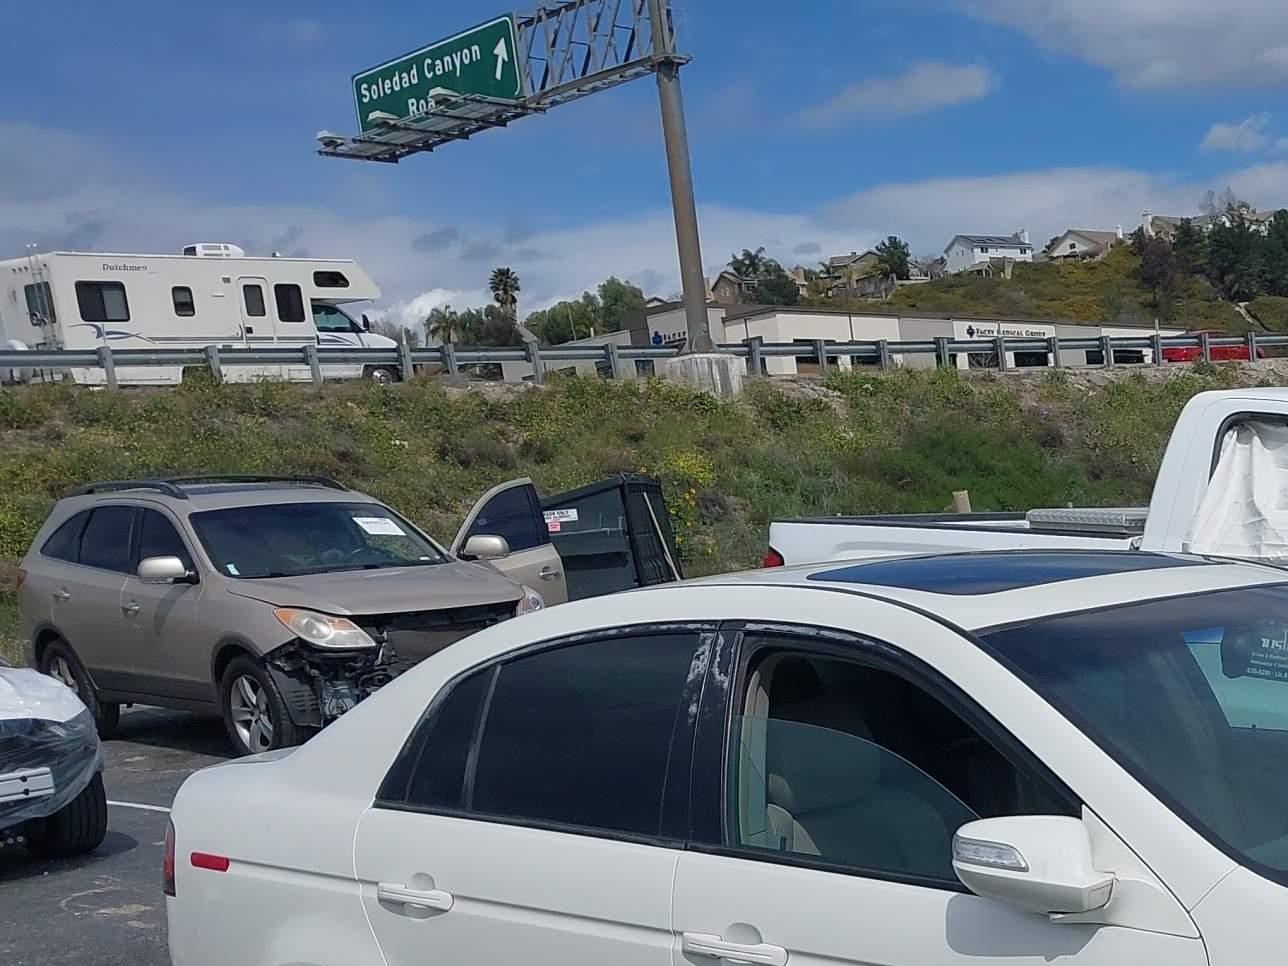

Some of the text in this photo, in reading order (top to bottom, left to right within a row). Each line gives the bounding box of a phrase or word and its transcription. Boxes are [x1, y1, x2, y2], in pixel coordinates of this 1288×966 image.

[360, 44, 481, 103] Soledad Canyon
[407, 97, 436, 116] Roa
[102, 263, 148, 271] Dutchmen
